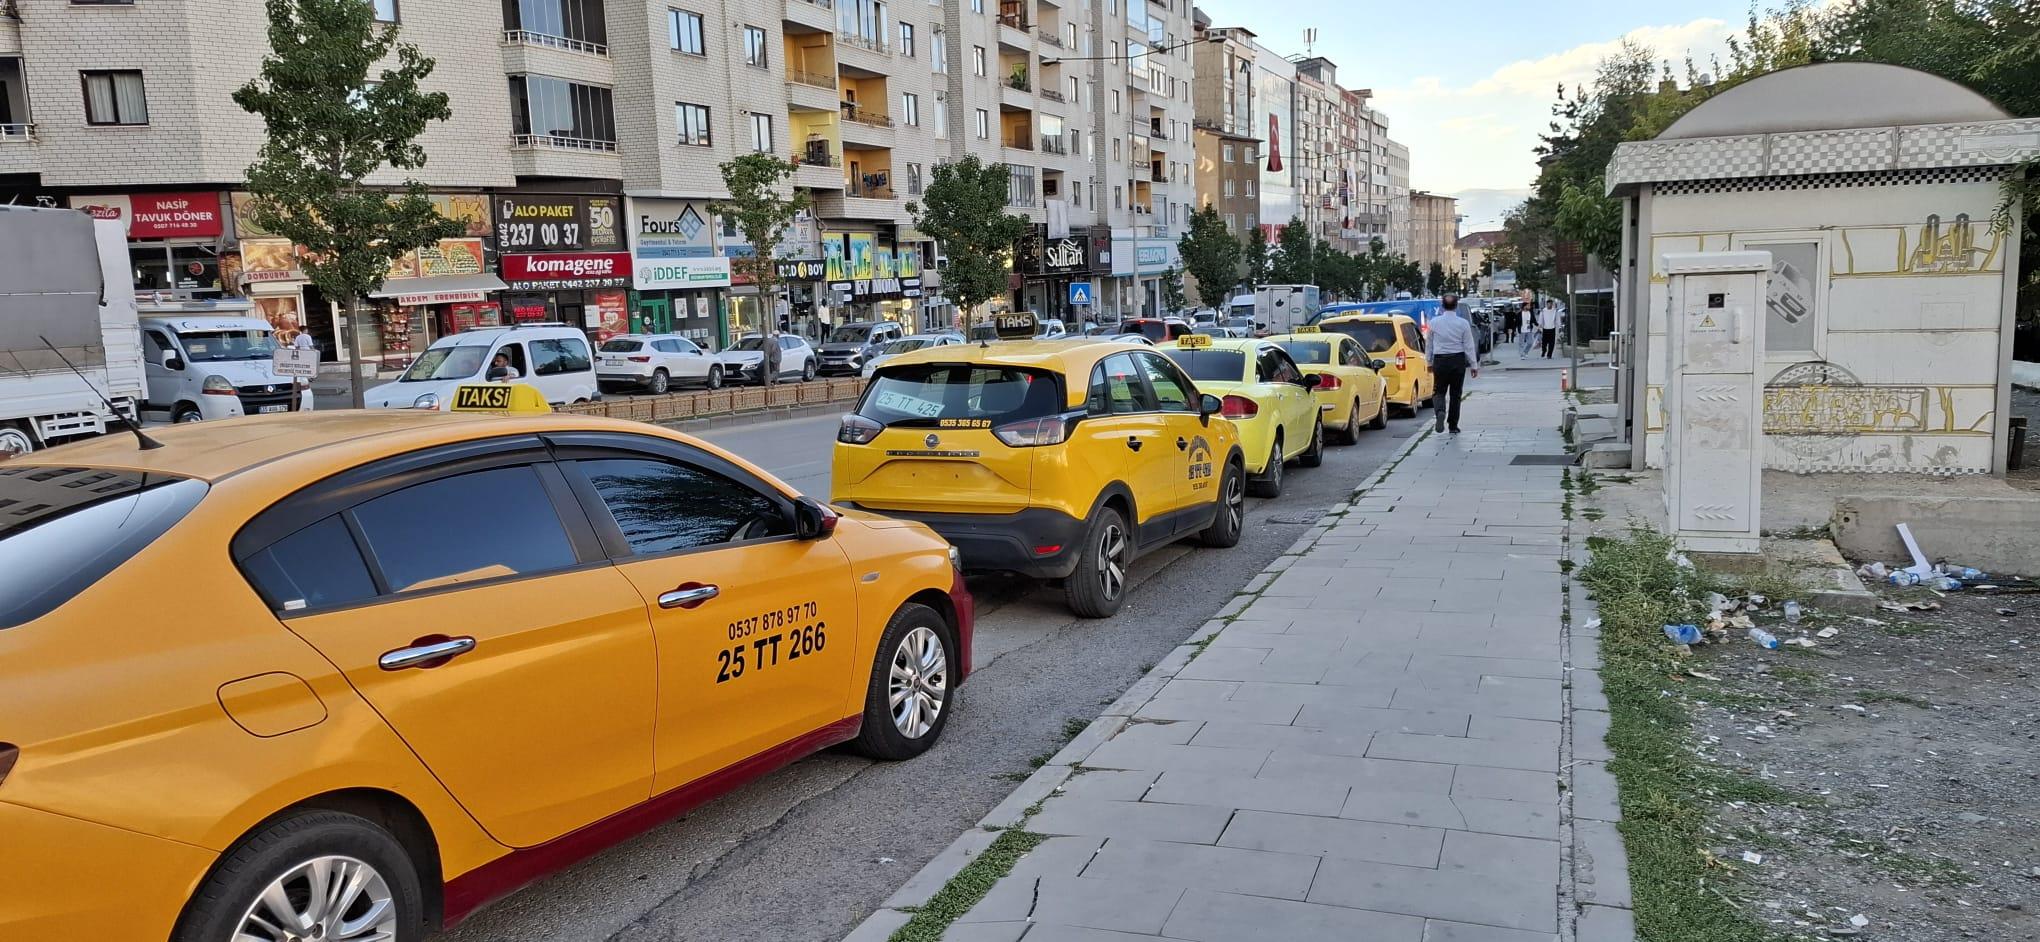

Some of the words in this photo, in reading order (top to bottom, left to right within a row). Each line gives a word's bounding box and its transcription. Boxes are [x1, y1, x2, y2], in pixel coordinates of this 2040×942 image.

[156, 198, 189, 210] NASİP
[515, 206, 537, 217] ALO
[540, 206, 574, 217] PAKET
[135, 213, 171, 222] TAVUK
[174, 211, 213, 221] DÖNER
[590, 206, 614, 228] 50
[641, 214, 680, 233] Fours
[499, 223, 509, 247] 0442
[509, 223, 534, 246] 237
[541, 223, 558, 245] 00
[563, 223, 579, 245] 37
[1047, 238, 1084, 267] Sultan
[526, 256, 613, 275] komagene
[807, 264, 824, 276] BOY
[247, 271, 290, 281] DONDURMA
[512, 281, 530, 290] ALO
[872, 278, 901, 294] MODA
[880, 392, 893, 405] 25
[897, 397, 914, 410] TT
[917, 401, 939, 416] 425
[940, 419, 957, 427] 0535
[728, 616, 758, 641] 0537
[762, 610, 784, 630] 878
[787, 606, 800, 623] 97
[804, 601, 817, 619] 70
[716, 645, 746, 683] 25
[753, 634, 783, 669] TT
[788, 621, 826, 660] 266
